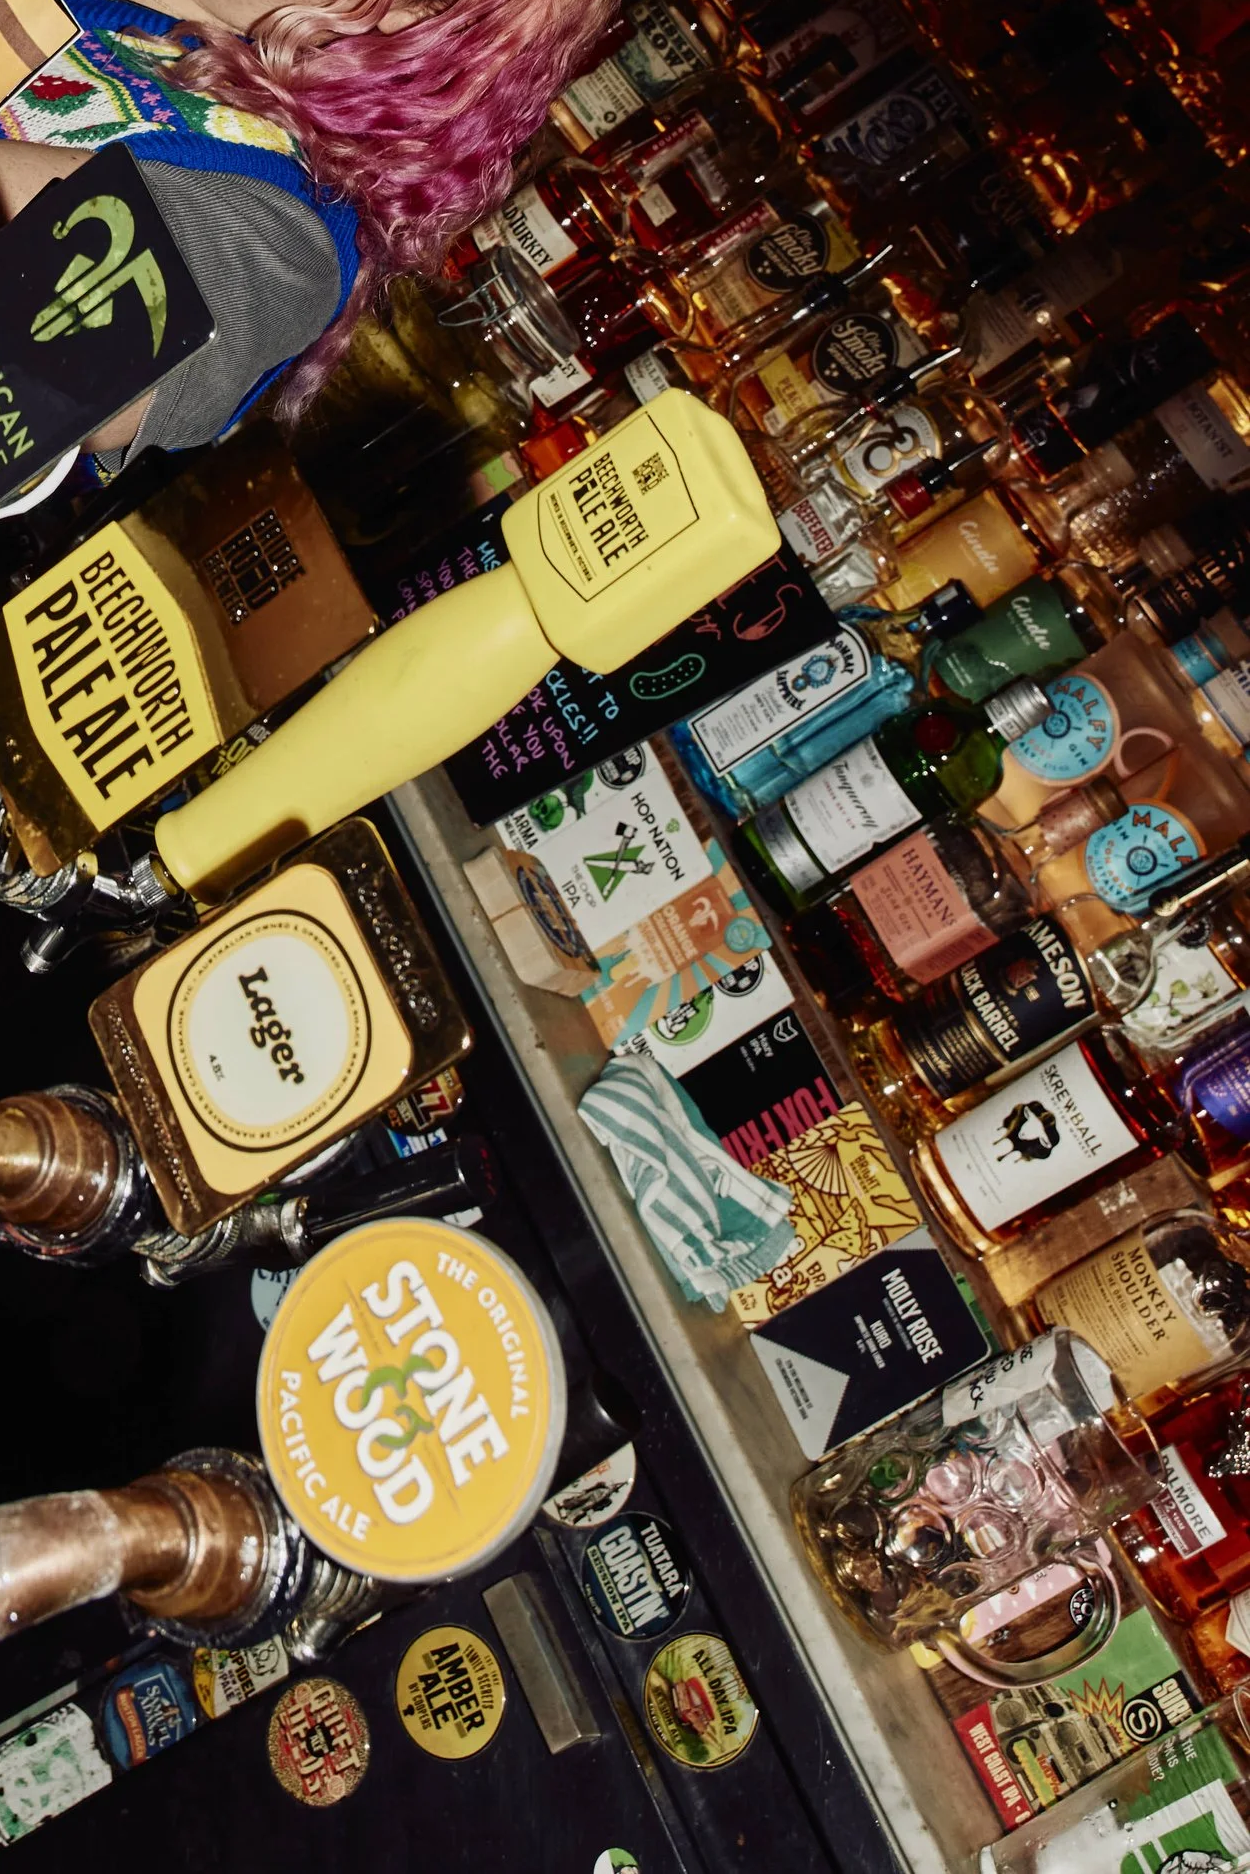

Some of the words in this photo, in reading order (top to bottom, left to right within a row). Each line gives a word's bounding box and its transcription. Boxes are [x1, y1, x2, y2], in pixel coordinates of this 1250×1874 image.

[636, 13, 685, 71] ROW
[507, 212, 555, 269] TURKEY
[771, 223, 821, 279] Smoky
[593, 452, 649, 549] BEECHWORTH
[791, 498, 836, 557] BEEFEATER
[253, 509, 306, 584] BRIDGE
[456, 546, 480, 580] THE
[589, 517, 629, 567] ALE
[25, 580, 116, 724] PALE
[79, 551, 194, 756] BEECHWORTH
[823, 633, 861, 678] BOMBAY
[545, 670, 599, 745] CKLES!!
[598, 691, 620, 720] TO
[769, 667, 809, 716] SAPPHIRE
[1051, 670, 1120, 754] MALFY
[61, 695, 155, 800] ALE
[481, 739, 509, 780] THE
[523, 723, 546, 760] YOU
[542, 716, 576, 770] UPON
[1067, 740, 1089, 768] GIN
[830, 758, 881, 834] Tanqueray
[512, 814, 538, 850] ARMA
[629, 791, 657, 828] HOP
[647, 825, 684, 882] NATION
[1126, 796, 1198, 879] MALF
[559, 879, 583, 909] IPA
[659, 902, 700, 961] ORANGE
[237, 966, 306, 1085] Lager
[955, 961, 987, 998] LACK
[971, 989, 1022, 1053] BARREL
[747, 1037, 763, 1057] IPA
[755, 1032, 775, 1060] Hazy
[1042, 1062, 1105, 1158] SKREWBALL
[852, 1153, 882, 1192] BRIGHT
[735, 1290, 752, 1313] ABV
[879, 1266, 922, 1324] MOLLY
[903, 1316, 943, 1365] ROSE
[1108, 1248, 1169, 1343] SHOULDER
[1125, 1245, 1180, 1326] MONKEY
[436, 1252, 476, 1291] THE
[478, 1287, 530, 1418] ORIGINAL
[867, 1318, 893, 1351] KURO
[361, 1260, 511, 1488] STONE
[307, 1303, 435, 1526] WOOD
[280, 1370, 327, 1499] PACIFIC
[319, 1494, 372, 1542] ALE
[1154, 1453, 1213, 1541] DALMORE
[587, 1546, 621, 1605] SESSION
[614, 1605, 634, 1632] IPA
[593, 1522, 672, 1634] COASTIN'
[637, 1520, 686, 1600] TUATARA
[215, 1671, 237, 1702] PALE
[407, 1681, 419, 1696] BY
[430, 1636, 491, 1735] AMBER
[459, 1642, 488, 1676] FAMILY
[475, 1671, 496, 1714] SECRETS
[691, 1647, 716, 1679] ALL
[706, 1676, 730, 1708] DAY
[133, 1691, 164, 1748] ADAMS
[143, 1681, 175, 1749] SAMUEL
[409, 1692, 434, 1732] COOPERS
[413, 1666, 457, 1732] ALE
[716, 1706, 738, 1738] IPA
[967, 1720, 995, 1755] WEST
[982, 1749, 1013, 1791] COAST
[1000, 1783, 1023, 1808] IPA
[1179, 1737, 1197, 1762] THE
